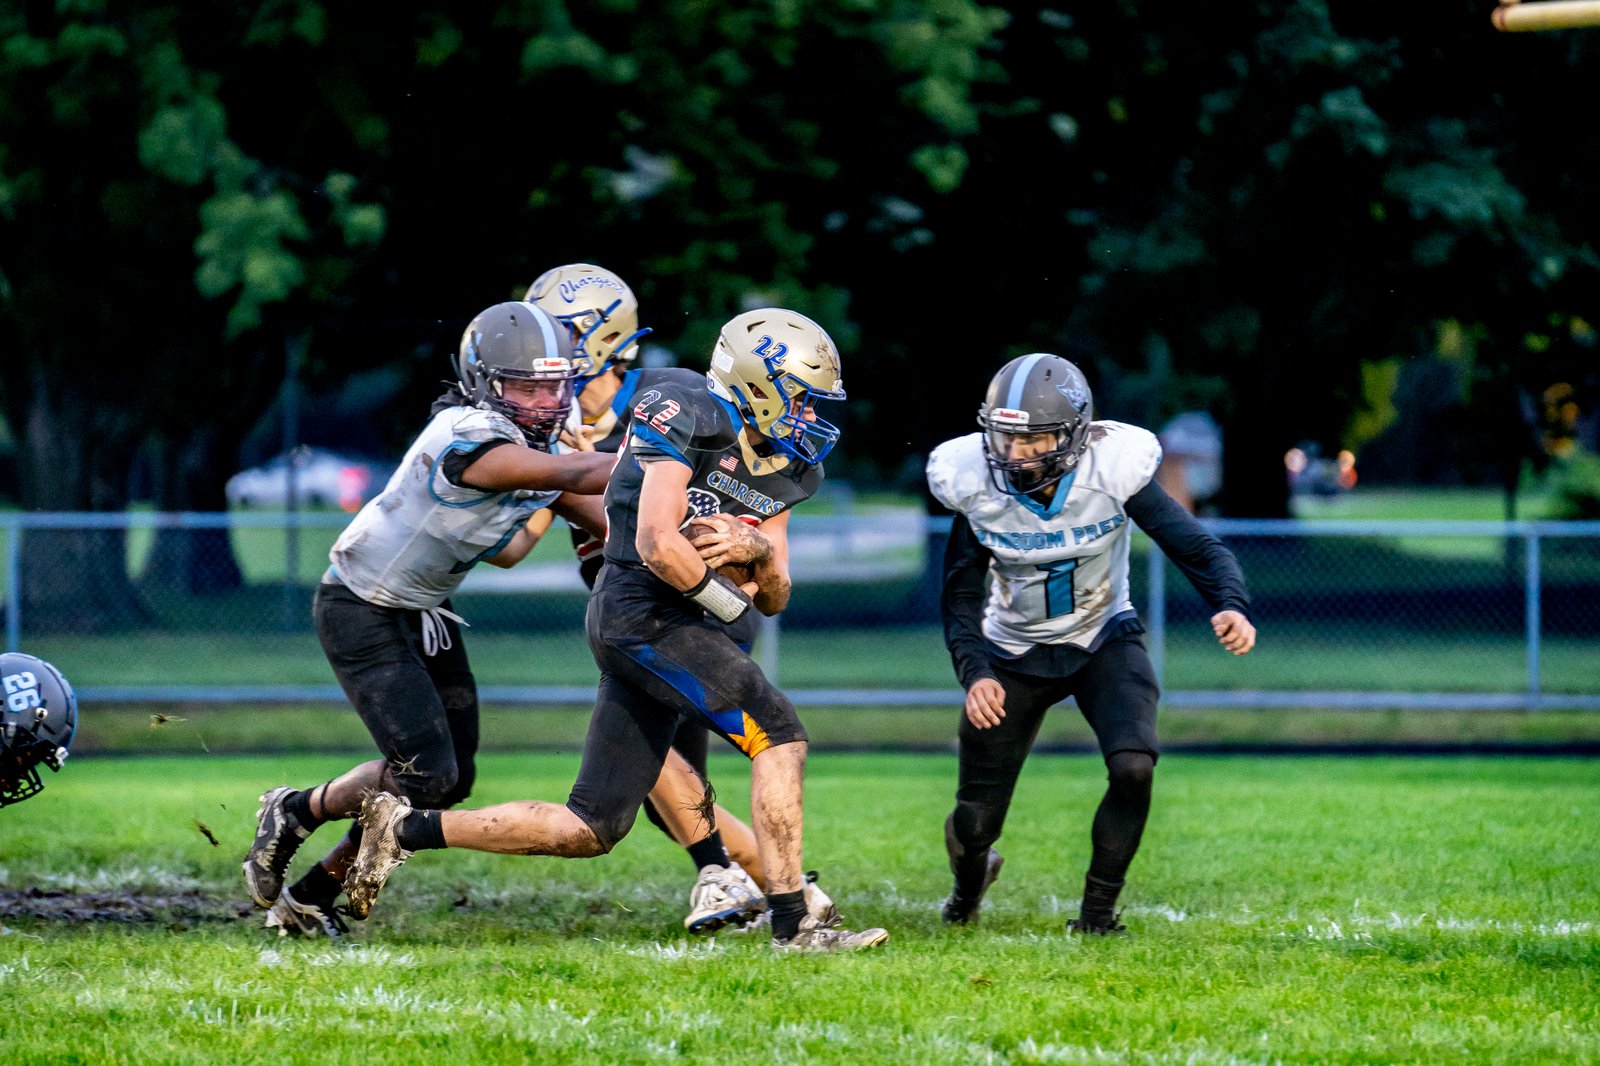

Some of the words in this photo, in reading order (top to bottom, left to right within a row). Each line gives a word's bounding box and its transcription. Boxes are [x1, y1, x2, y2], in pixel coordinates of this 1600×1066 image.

[751, 334, 789, 368] 22
[633, 389, 681, 435] 22
[706, 470, 786, 516] CHARGERS
[3, 671, 41, 712] 26
